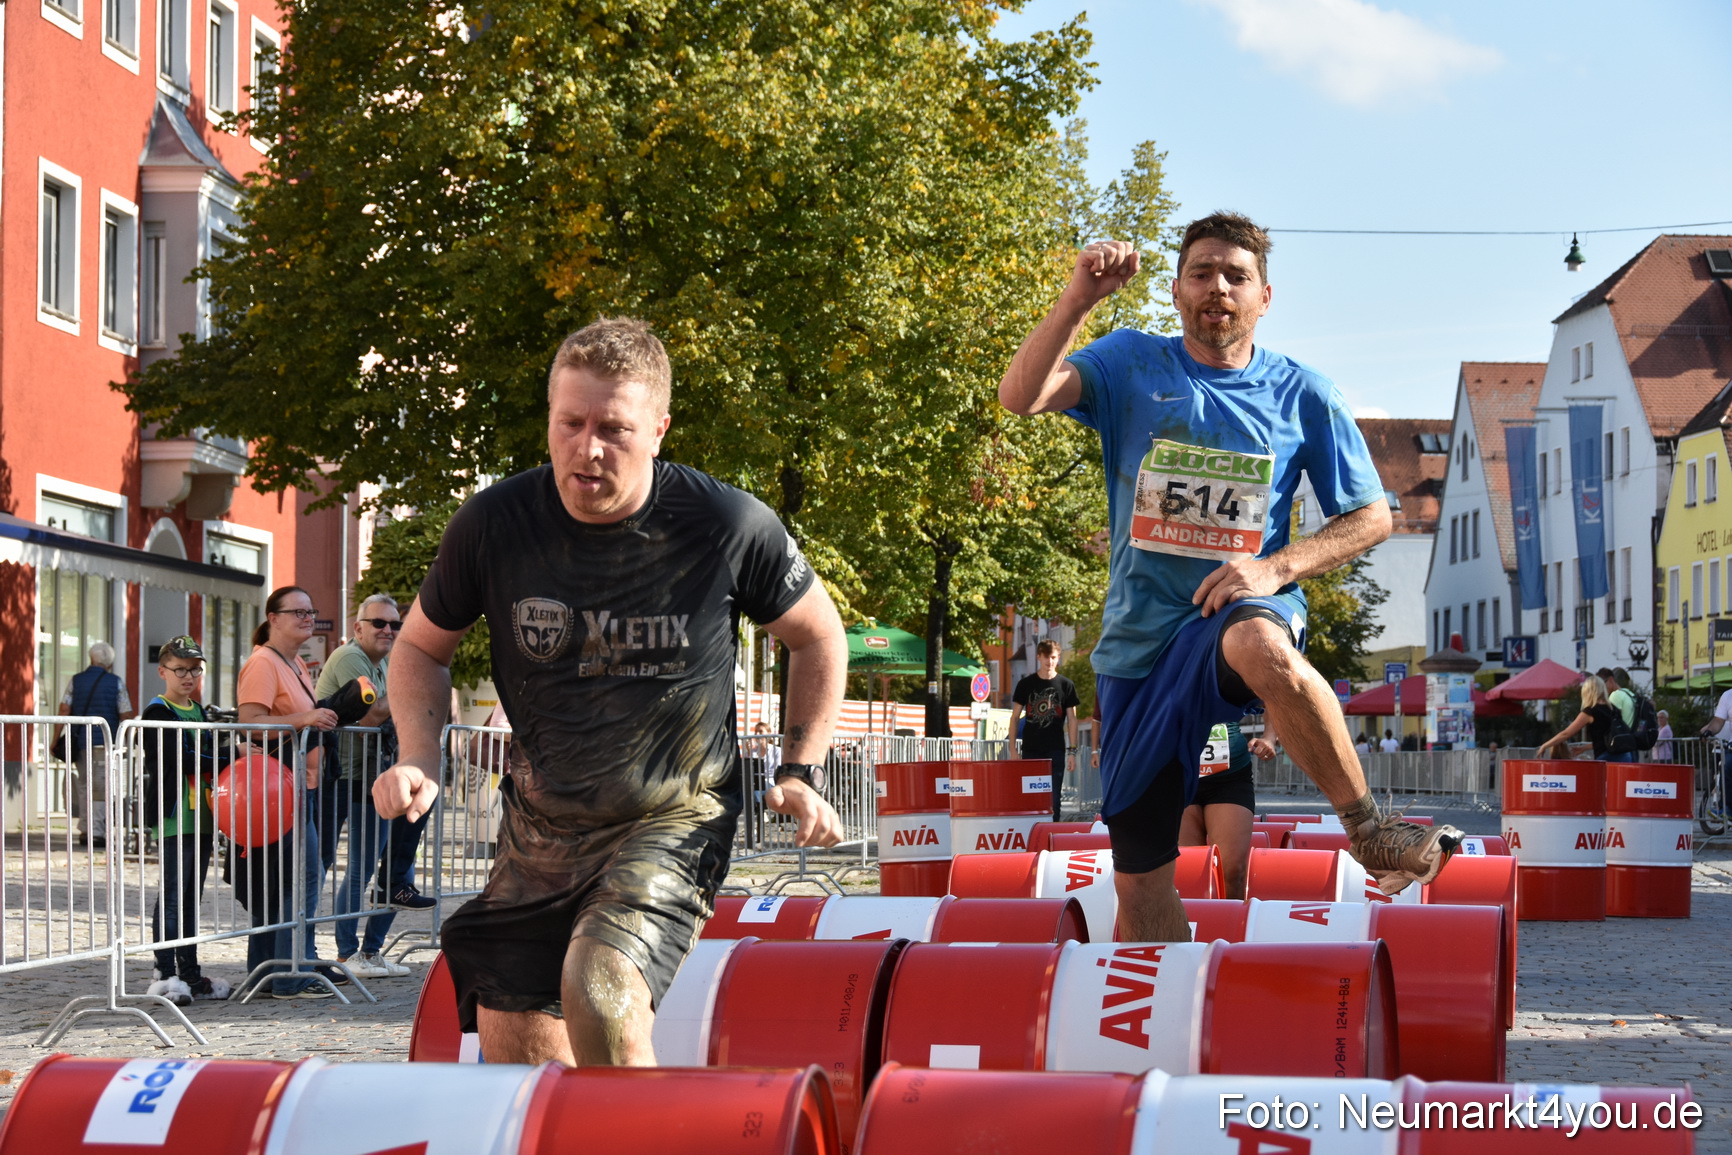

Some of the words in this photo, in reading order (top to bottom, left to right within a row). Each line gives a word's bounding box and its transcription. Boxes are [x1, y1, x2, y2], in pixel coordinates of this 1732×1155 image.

[1152, 445, 1266, 479] BOCK
[1165, 481, 1240, 521] 514
[1150, 524, 1244, 549] ANDREAS
[1697, 530, 1718, 553] HOTEL
[526, 606, 559, 622] XLETIX
[580, 610, 690, 657] XLETIX
[639, 662, 659, 676] Ein
[893, 825, 939, 846] AVIA
[975, 828, 1026, 850] AVIA
[1096, 944, 1166, 1050] AVIA
[833, 1062, 845, 1087] 323
[743, 1111, 763, 1138] 323
